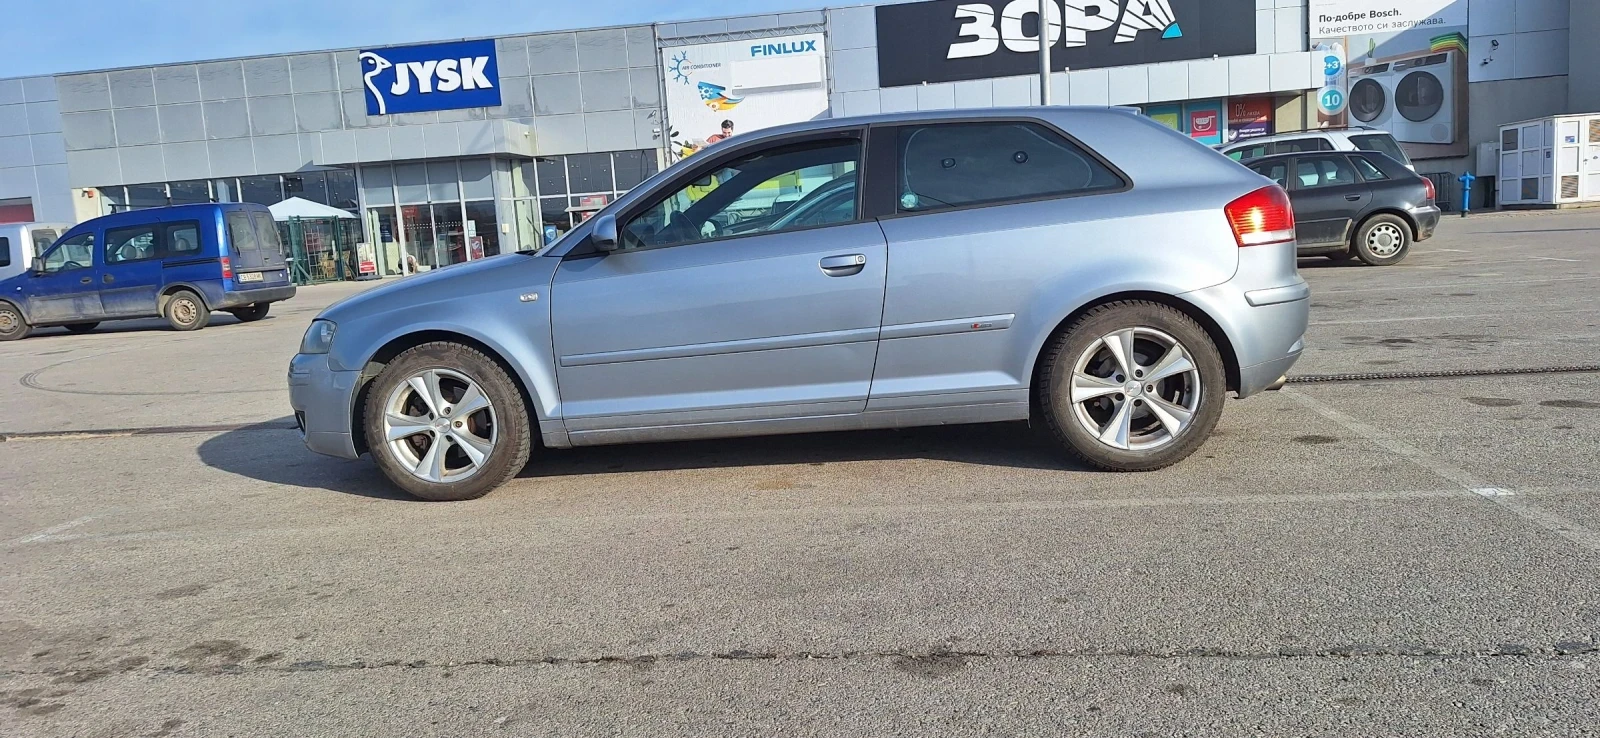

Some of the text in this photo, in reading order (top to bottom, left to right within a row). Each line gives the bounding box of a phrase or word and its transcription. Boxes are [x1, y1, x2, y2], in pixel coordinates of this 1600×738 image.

[1319, 8, 1402, 23] По-добре Bosch.
[1319, 23, 1374, 34] Качеството
[1392, 17, 1446, 28] заслужава.
[751, 40, 816, 57] FINLUX
[690, 62, 721, 70] CONDITIONER
[391, 56, 493, 95] JYSK
[1325, 94, 1340, 106] 10
